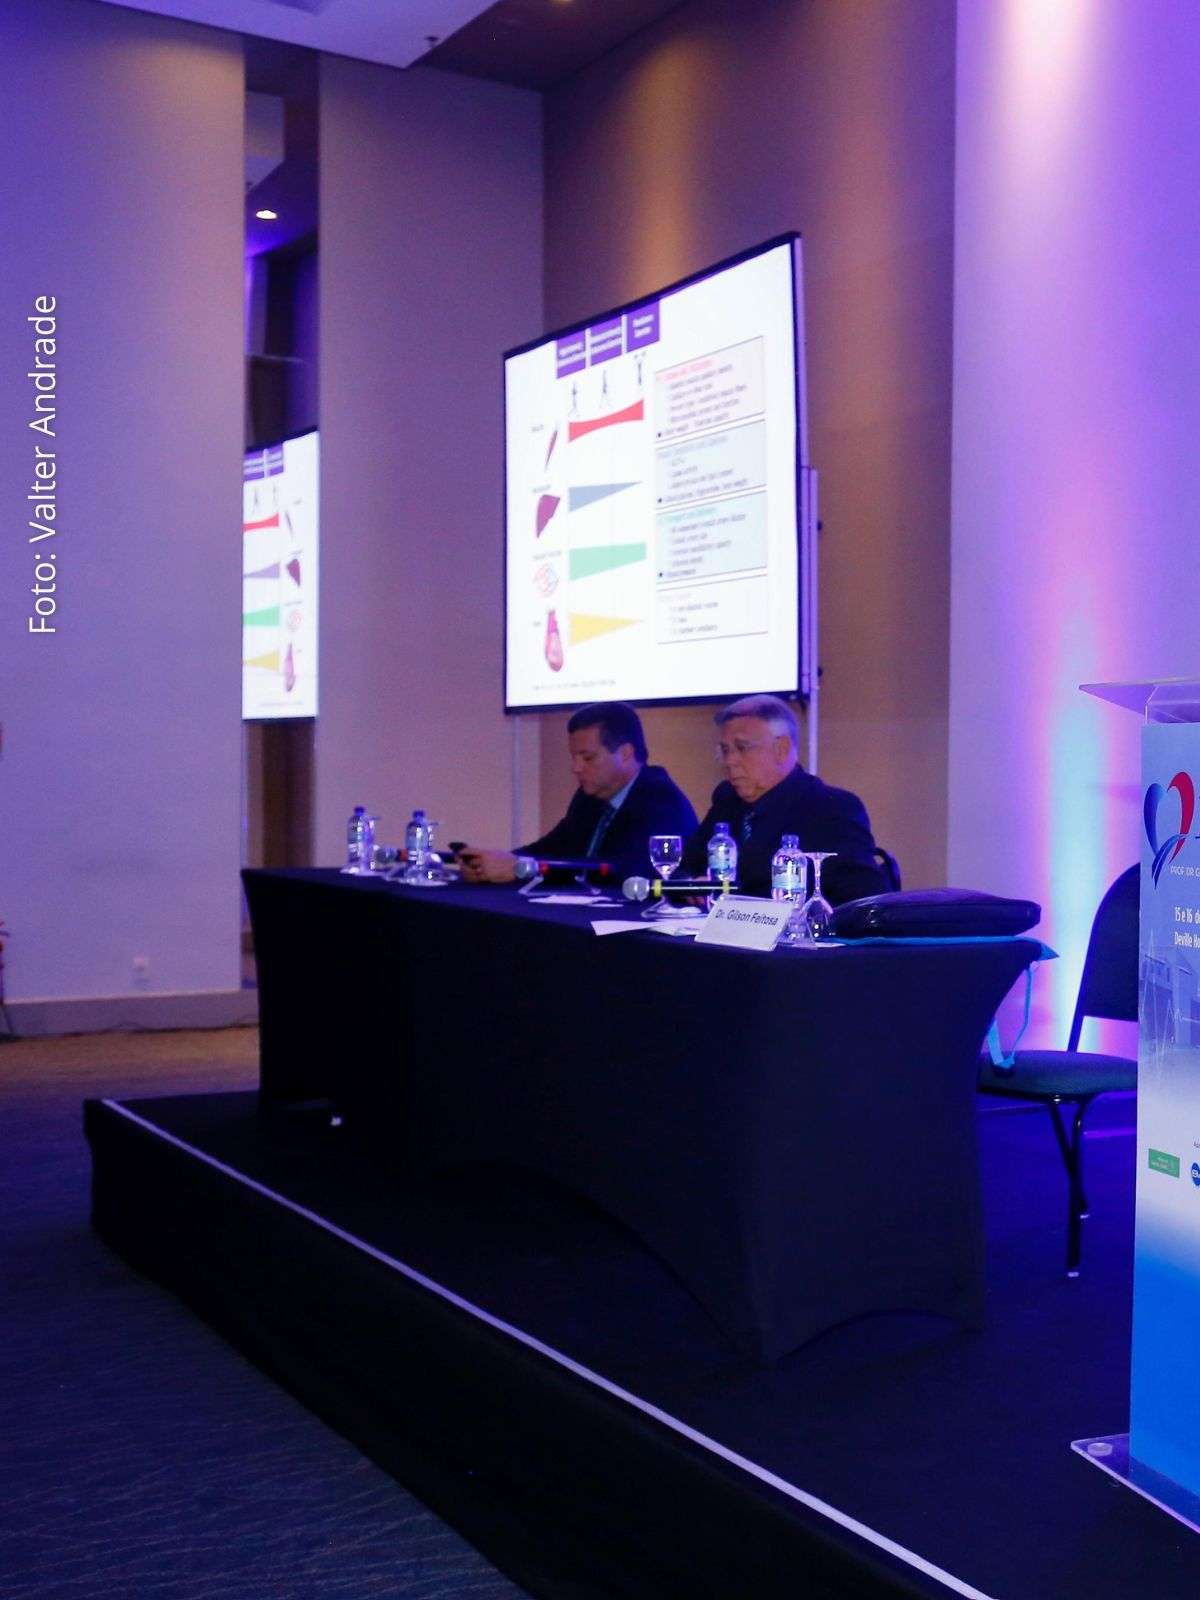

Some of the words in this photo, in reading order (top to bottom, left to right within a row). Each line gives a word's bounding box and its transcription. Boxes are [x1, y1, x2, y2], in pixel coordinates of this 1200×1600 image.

[727, 908, 751, 922] Gilson
[750, 912, 779, 926] Feitosa
[1174, 931, 1193, 947] Deville
